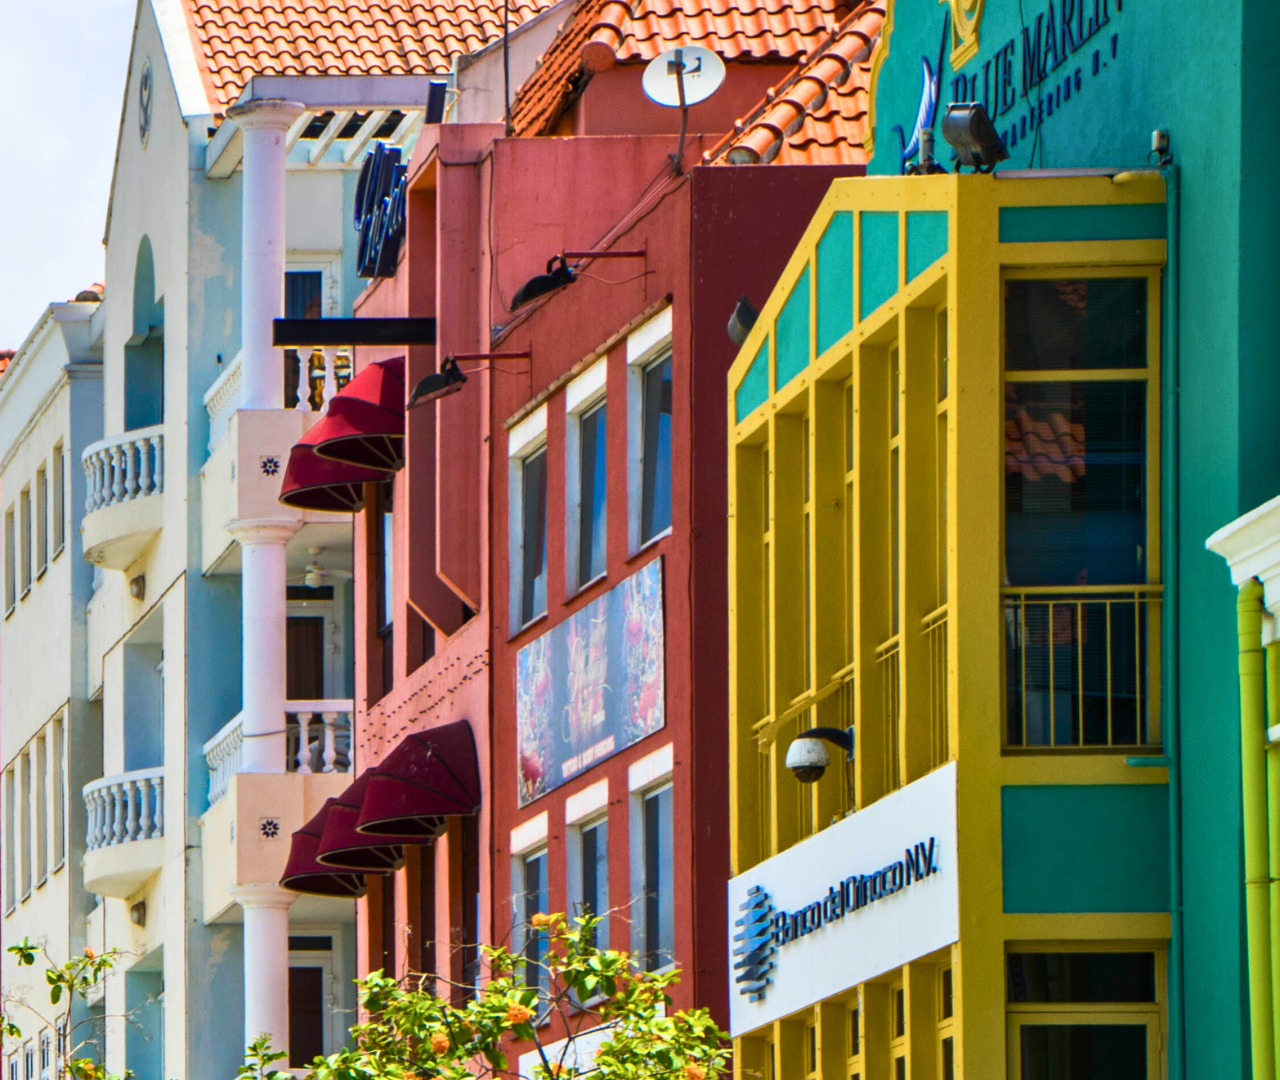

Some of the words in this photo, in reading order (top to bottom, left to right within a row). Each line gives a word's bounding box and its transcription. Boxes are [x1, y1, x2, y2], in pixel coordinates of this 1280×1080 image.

[950, 38, 1015, 135] UE
[1019, 0, 1122, 98] MARL
[774, 901, 821, 948] Banco
[823, 881, 845, 923] del
[846, 860, 903, 913] Orinoco
[905, 836, 938, 886] N.V.
